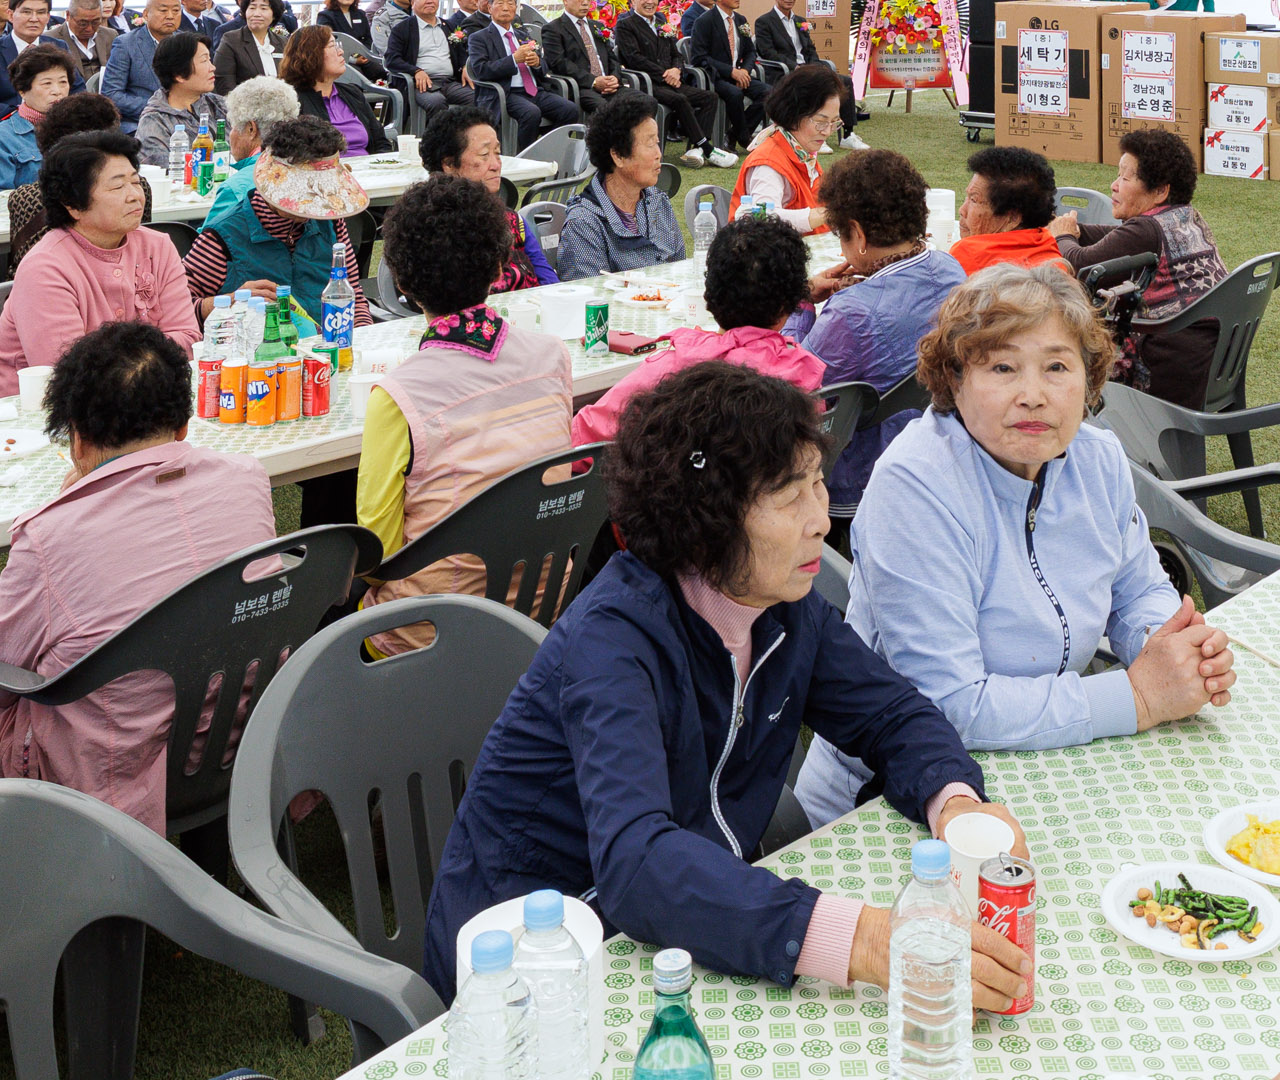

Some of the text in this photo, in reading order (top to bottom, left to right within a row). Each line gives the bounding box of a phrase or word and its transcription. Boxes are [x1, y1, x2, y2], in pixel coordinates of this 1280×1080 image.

[1044, 19, 1060, 31] LG
[1020, 46, 1066, 64] 세탁기
[1124, 49, 1174, 63] 김치냉장고
[1132, 84, 1165, 96] 경남건재
[1026, 93, 1061, 107] 이형오
[1136, 97, 1173, 113] 손영준
[538, 489, 585, 512] 넘보원 렌탈
[1029, 550, 1059, 607] VICTOR
[234, 584, 293, 615] 넘보원 렌탈
[231, 598, 289, 624] 010-7433-0335
